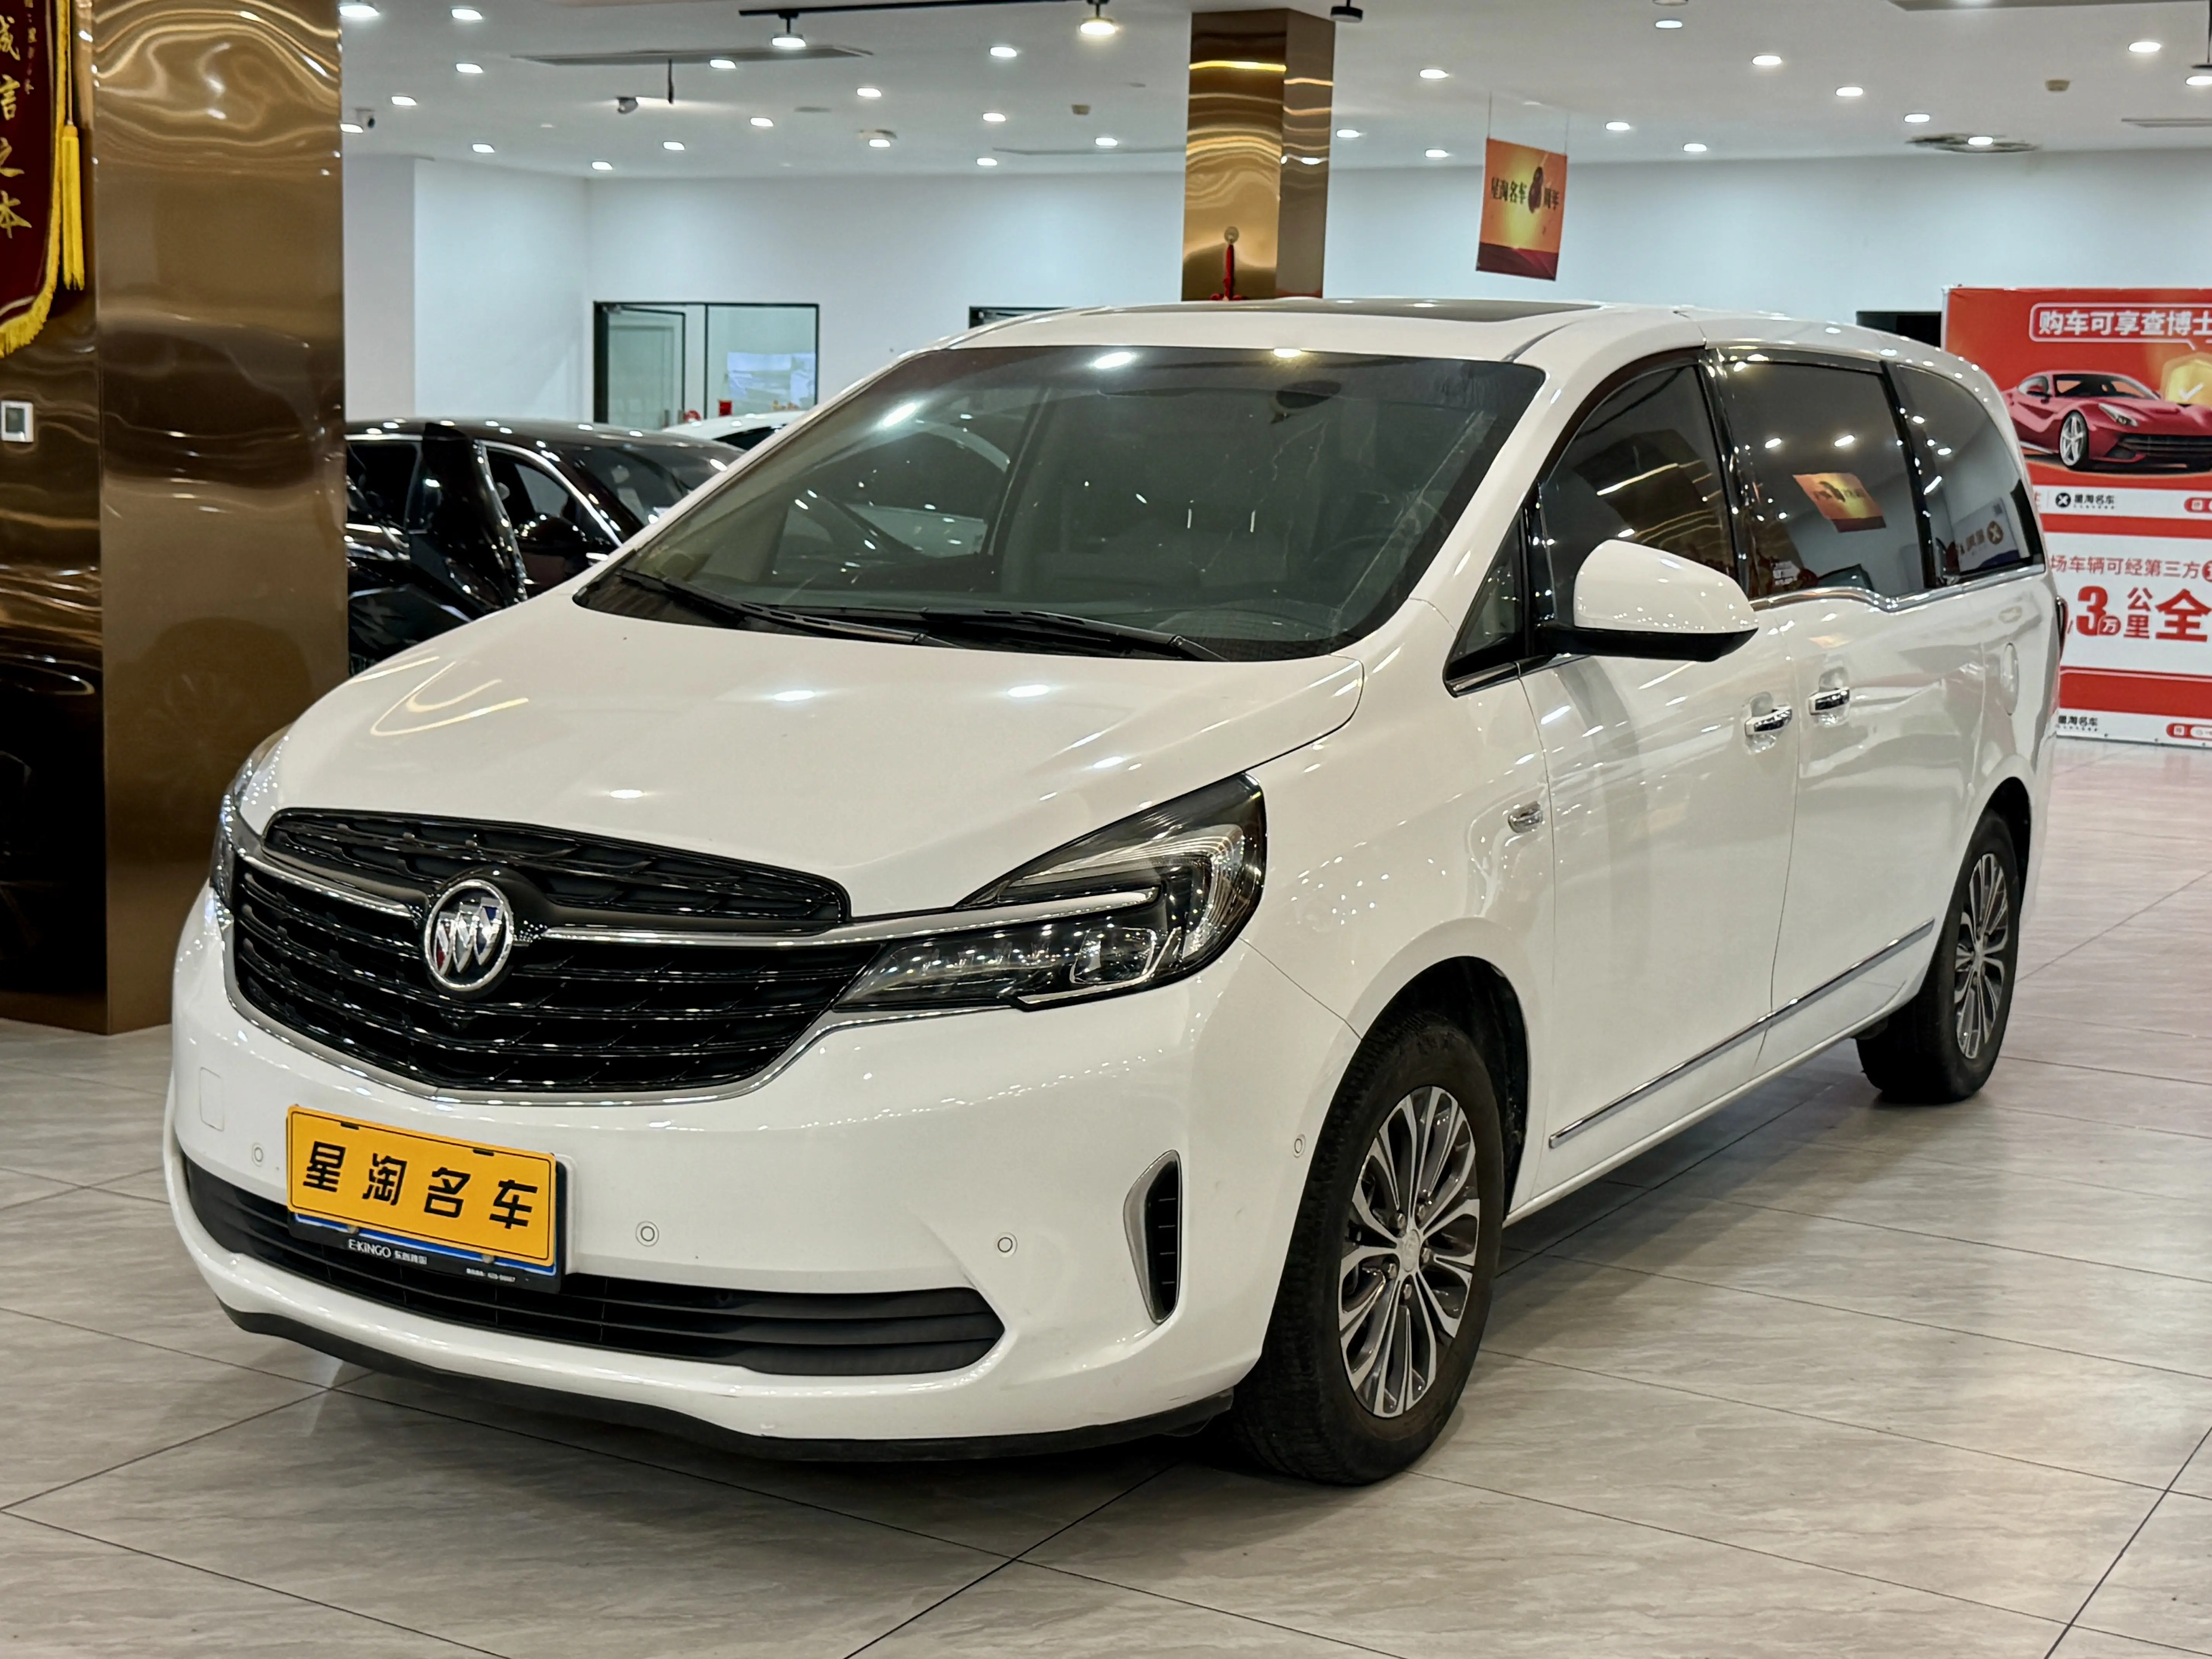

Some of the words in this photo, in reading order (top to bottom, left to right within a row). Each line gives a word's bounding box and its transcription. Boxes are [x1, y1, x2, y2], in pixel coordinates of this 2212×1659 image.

[2039, 311, 2212, 336] 购车可享查博士
[303, 1140, 538, 1229] 星淘名车
